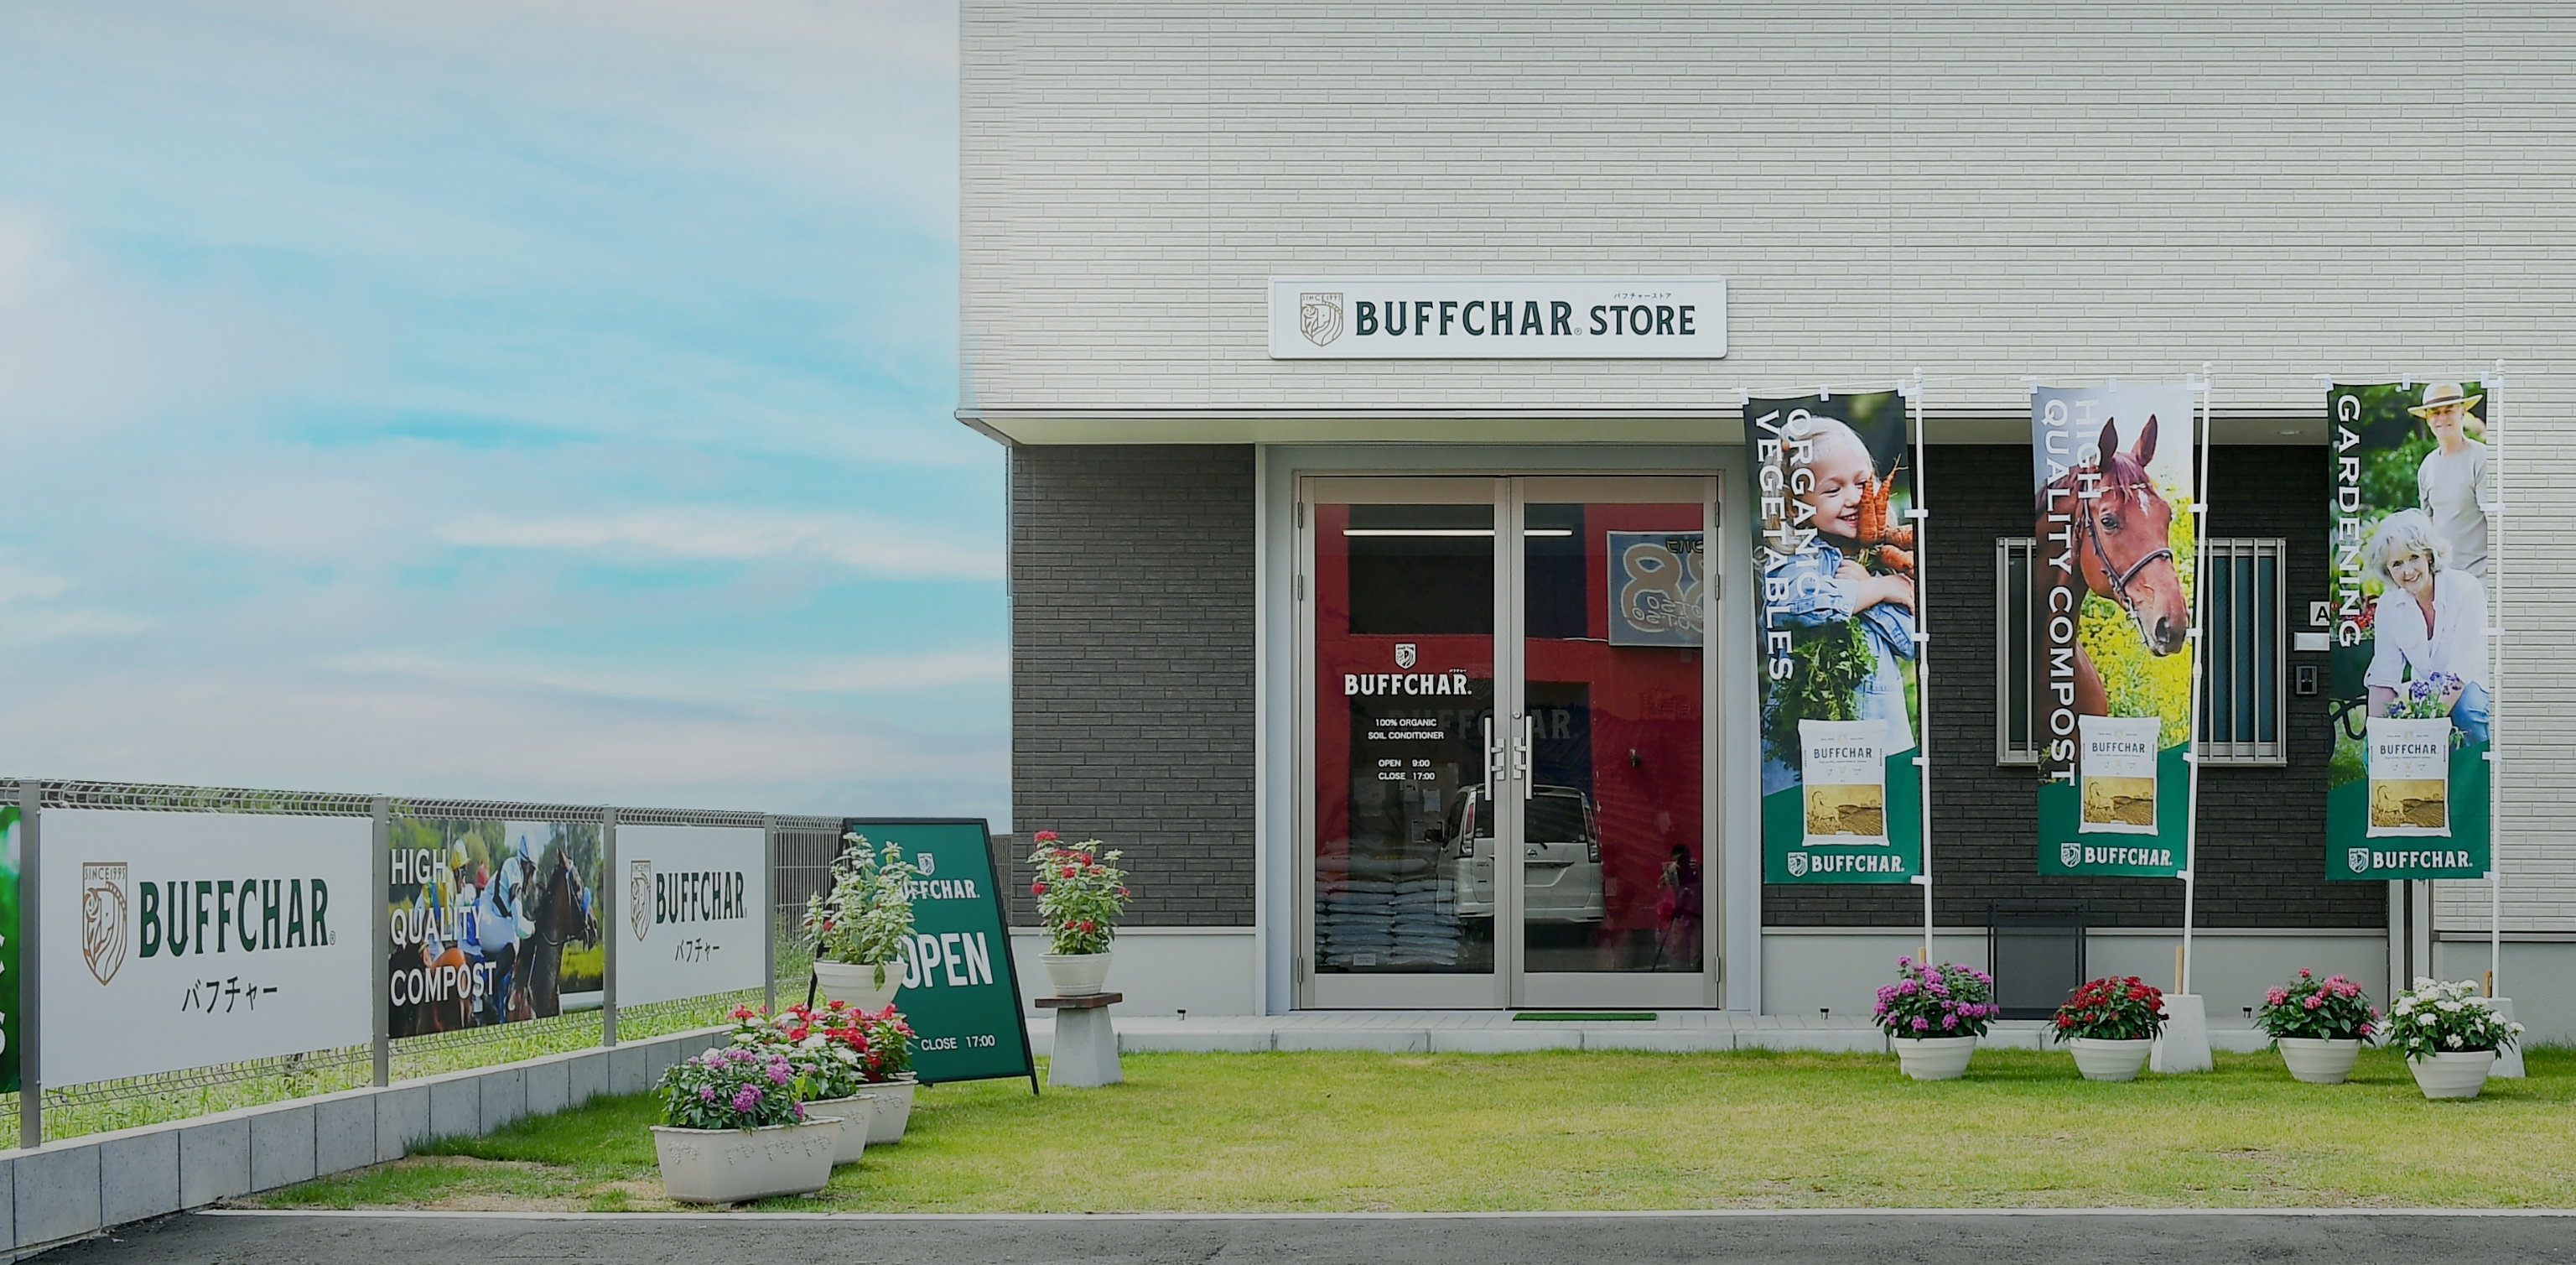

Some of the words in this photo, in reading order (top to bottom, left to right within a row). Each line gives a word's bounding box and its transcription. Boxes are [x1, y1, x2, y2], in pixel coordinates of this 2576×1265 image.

[1590, 305, 1696, 336] STORE
[2075, 399, 2102, 500] HIGH
[1787, 408, 1821, 598] ORGANIC
[2041, 398, 2073, 575] QUALITY
[2338, 393, 2361, 648] GARDENING
[1755, 409, 1794, 681] VEGETABLES
[2049, 586, 2076, 787] COMPOST
[1368, 731, 1387, 740] SOIL
[1388, 731, 1445, 740] CONDITIONER
[1378, 759, 1401, 768] OPEN
[1412, 759, 1431, 768] 9:00
[391, 848, 447, 885] HIGH
[390, 905, 484, 950] QUALITY
[674, 937, 720, 963] バフチャー
[390, 960, 497, 1007] COMPOST
[896, 931, 995, 990] OPEN
[181, 976, 278, 1014] バフチャー
[921, 1037, 958, 1052] CLOSE
[965, 1034, 996, 1049] 17:00
